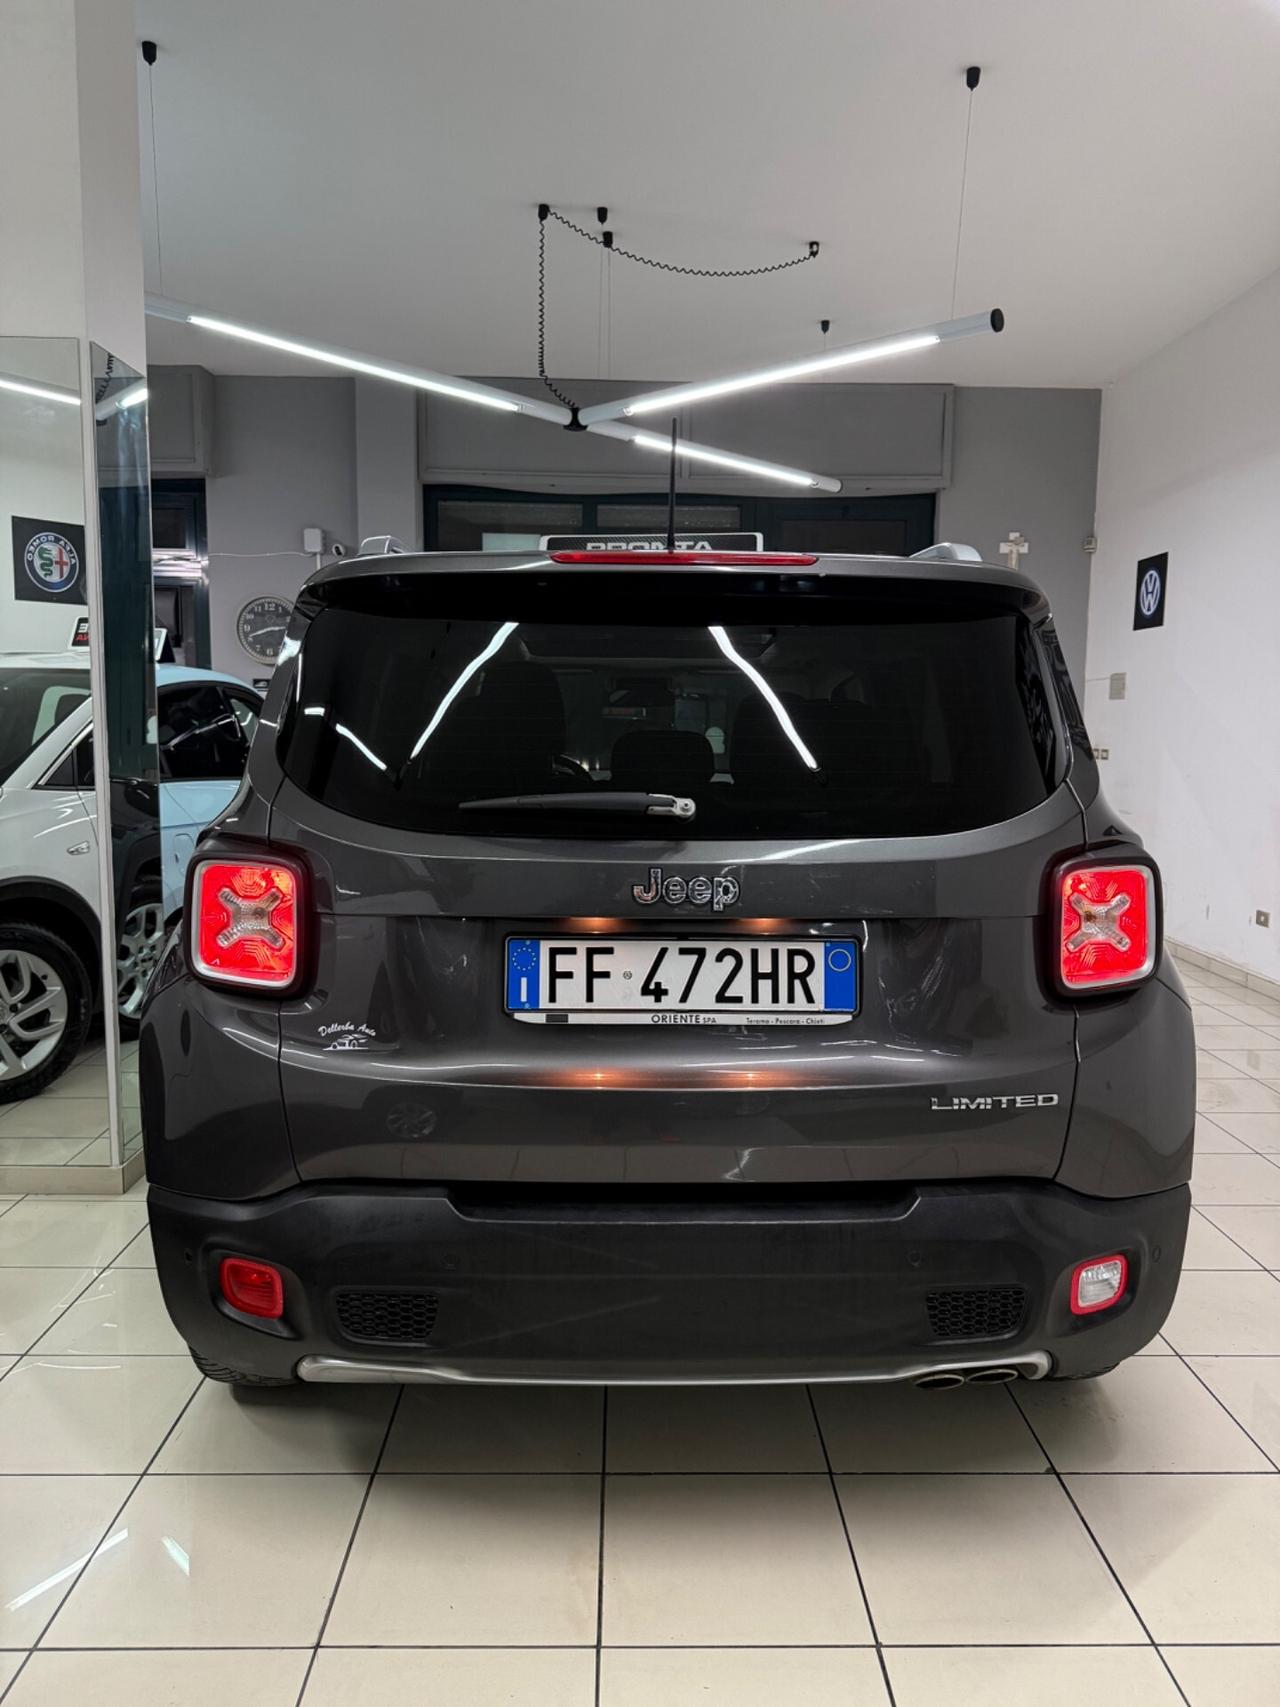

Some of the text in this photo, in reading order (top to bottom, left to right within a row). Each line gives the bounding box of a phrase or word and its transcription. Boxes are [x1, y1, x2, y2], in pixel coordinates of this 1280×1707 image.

[633, 868, 739, 911] Jeep
[548, 947, 815, 1004] FF 472HR
[651, 1014, 717, 1025] ORIENTE SPA
[357, 1024, 376, 1036] Auto
[931, 1094, 1059, 1110] LIMITED
